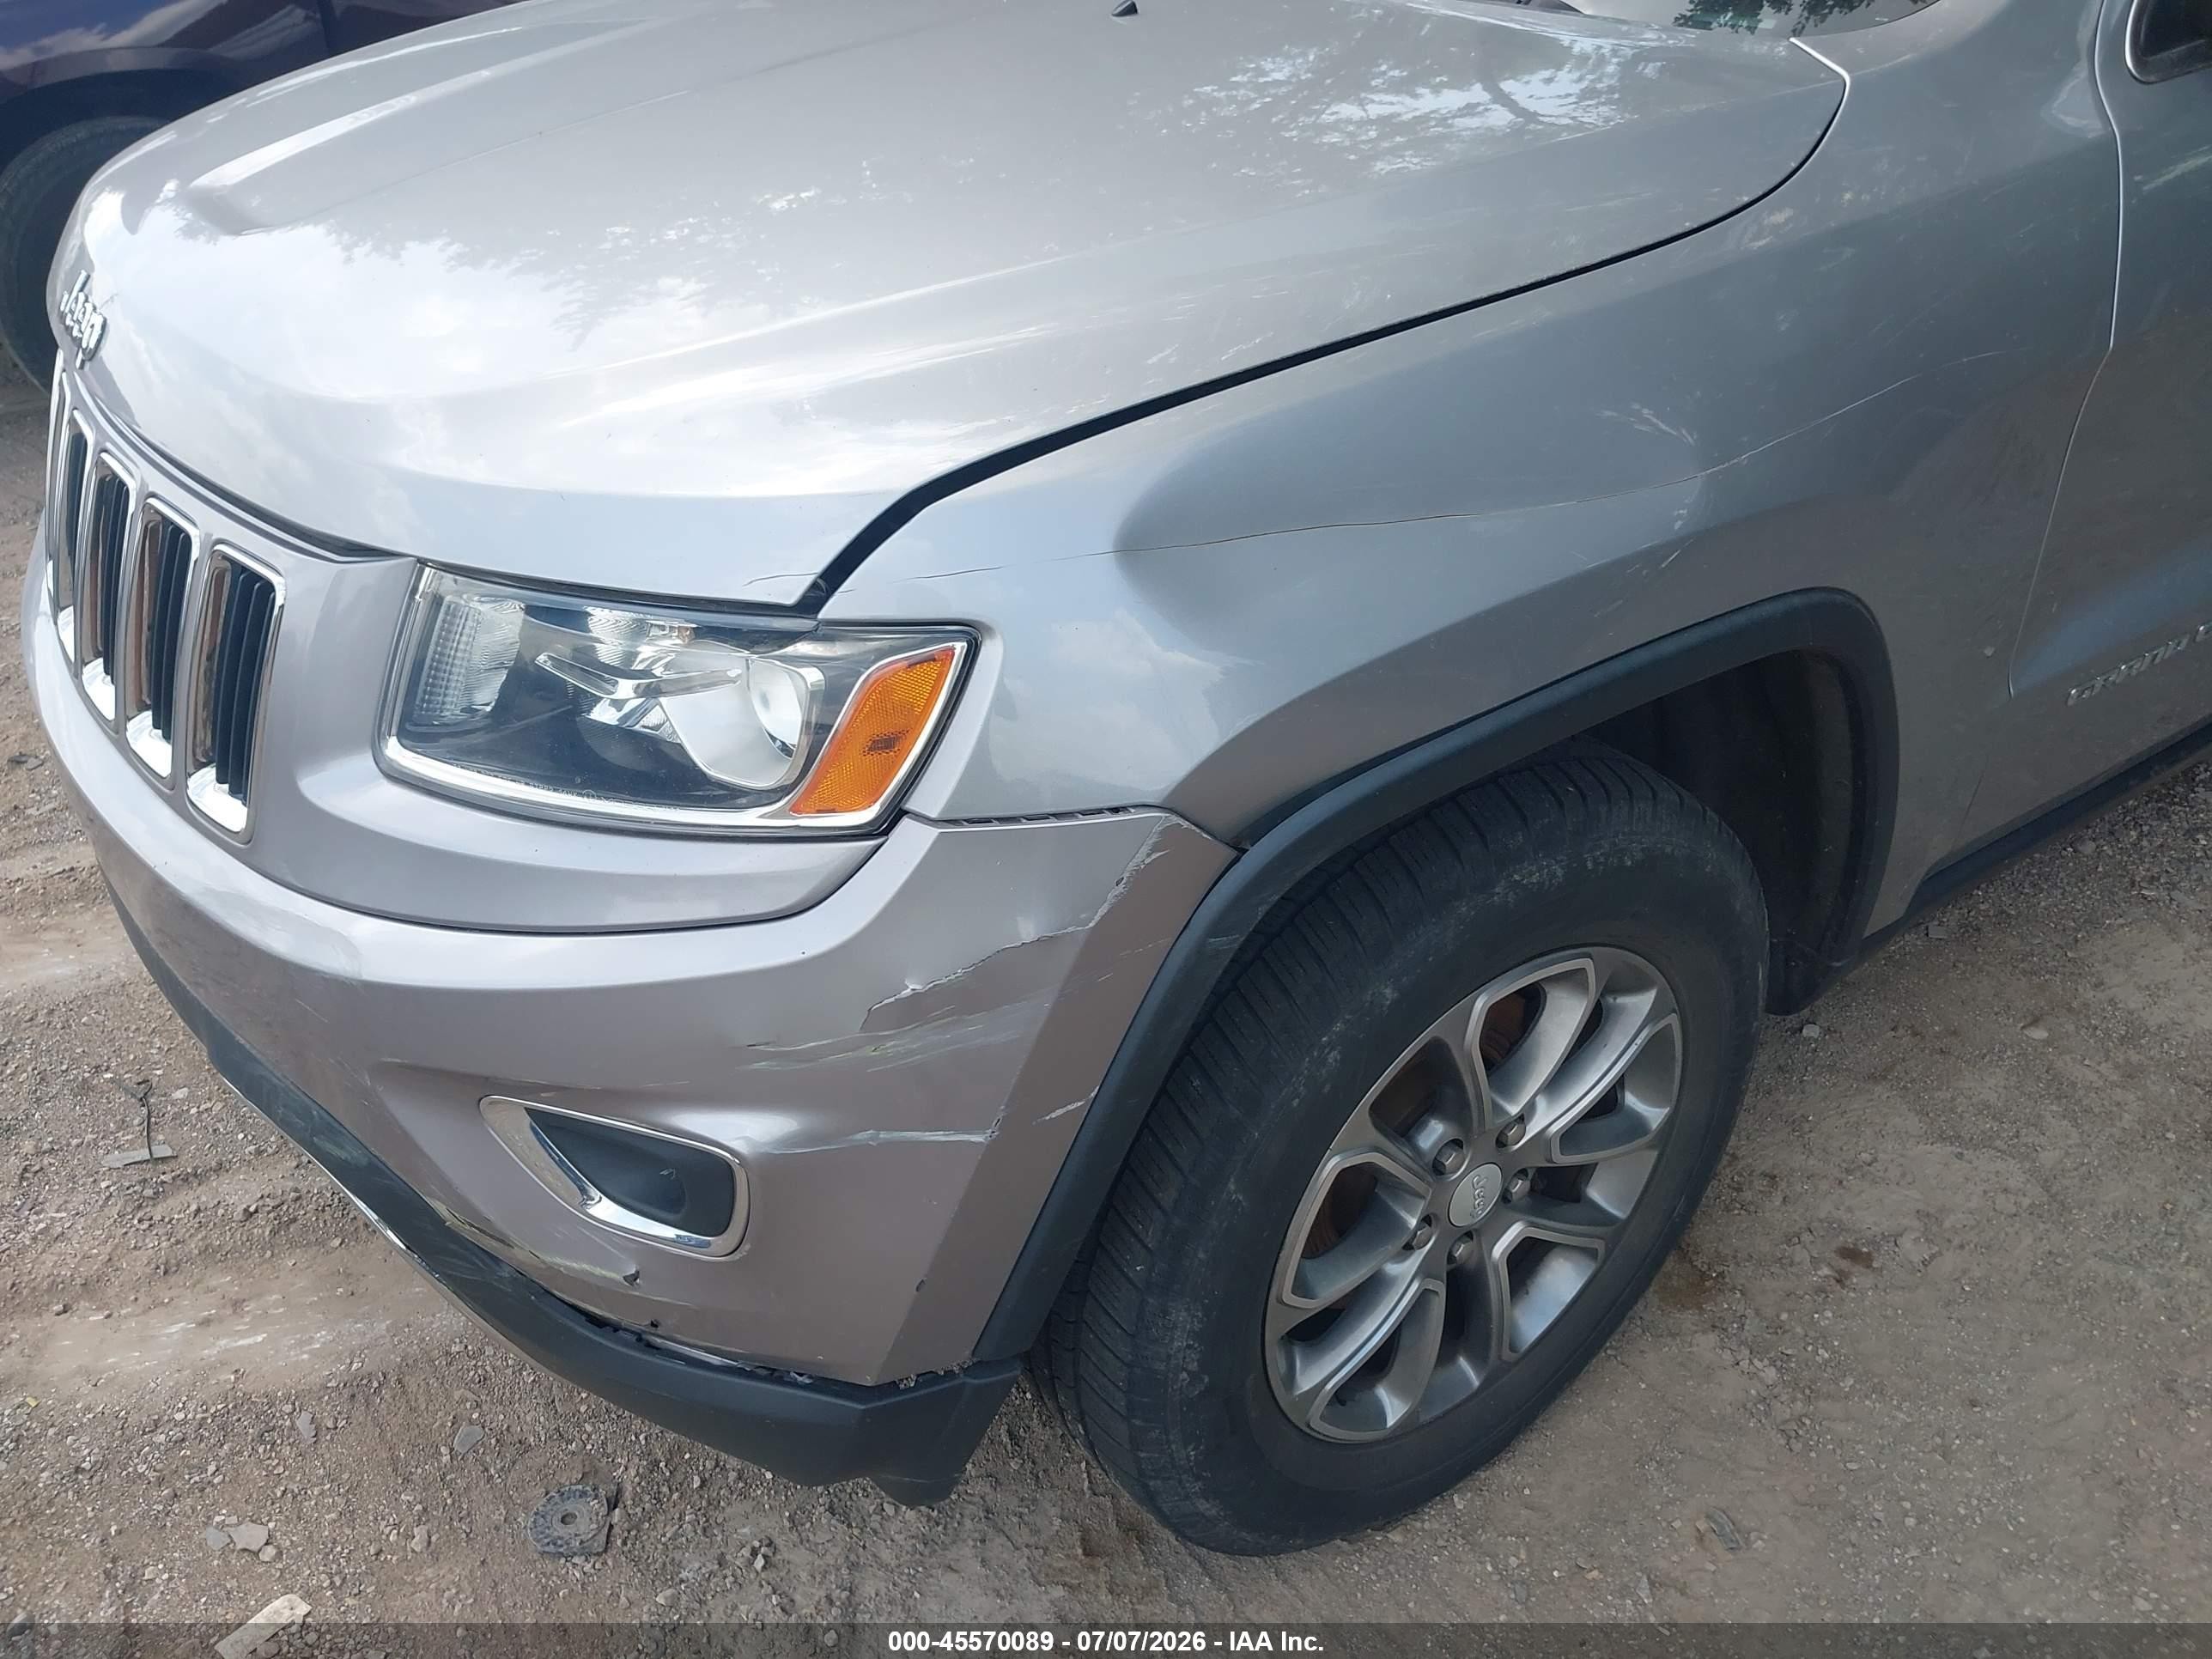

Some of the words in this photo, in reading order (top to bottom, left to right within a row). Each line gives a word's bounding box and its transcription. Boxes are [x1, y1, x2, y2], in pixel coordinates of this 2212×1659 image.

[59, 269, 107, 369] Jeep
[2067, 633, 2191, 707] GRAND
[1469, 1174, 1489, 1219] Jeep
